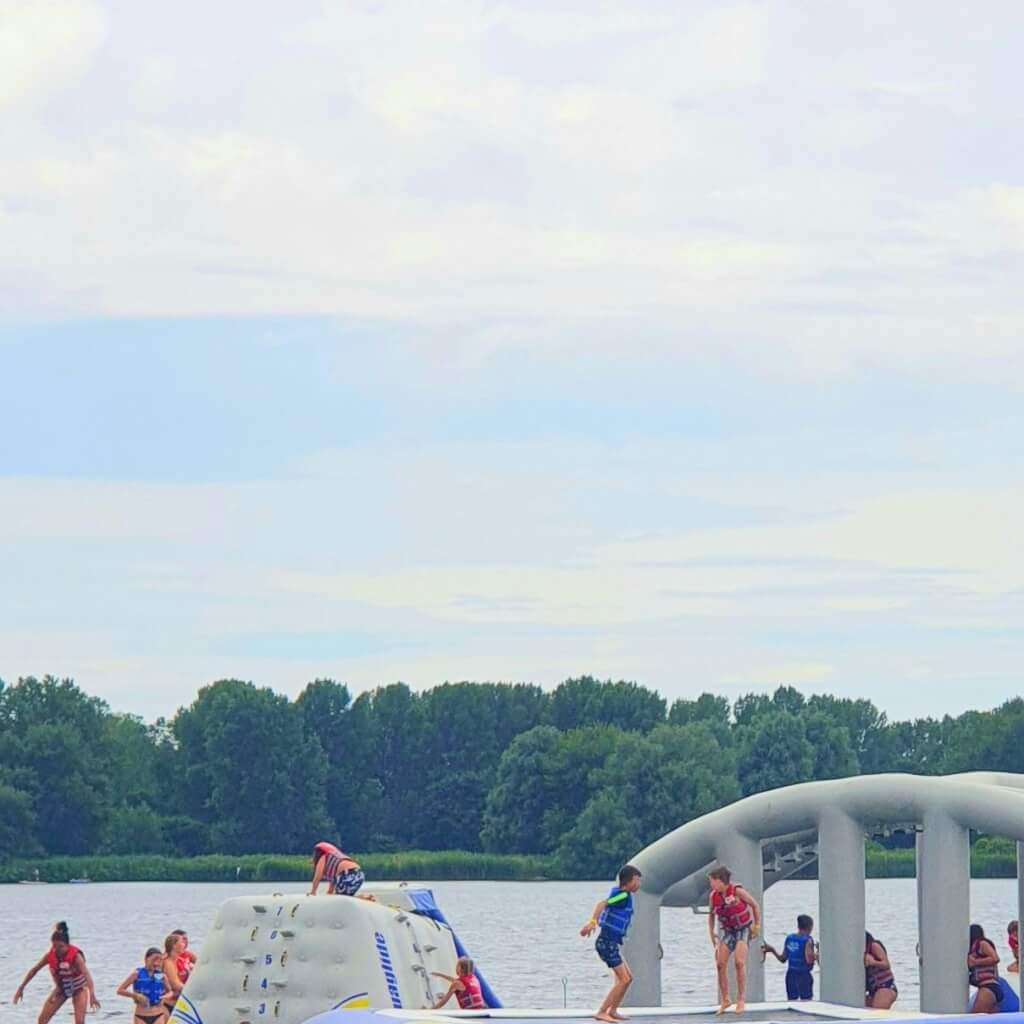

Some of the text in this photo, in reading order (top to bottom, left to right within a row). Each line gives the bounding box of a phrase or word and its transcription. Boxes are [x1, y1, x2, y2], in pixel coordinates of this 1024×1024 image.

[265, 954, 272, 965] 5
[260, 978, 268, 989] 4
[258, 1003, 265, 1014] 3
